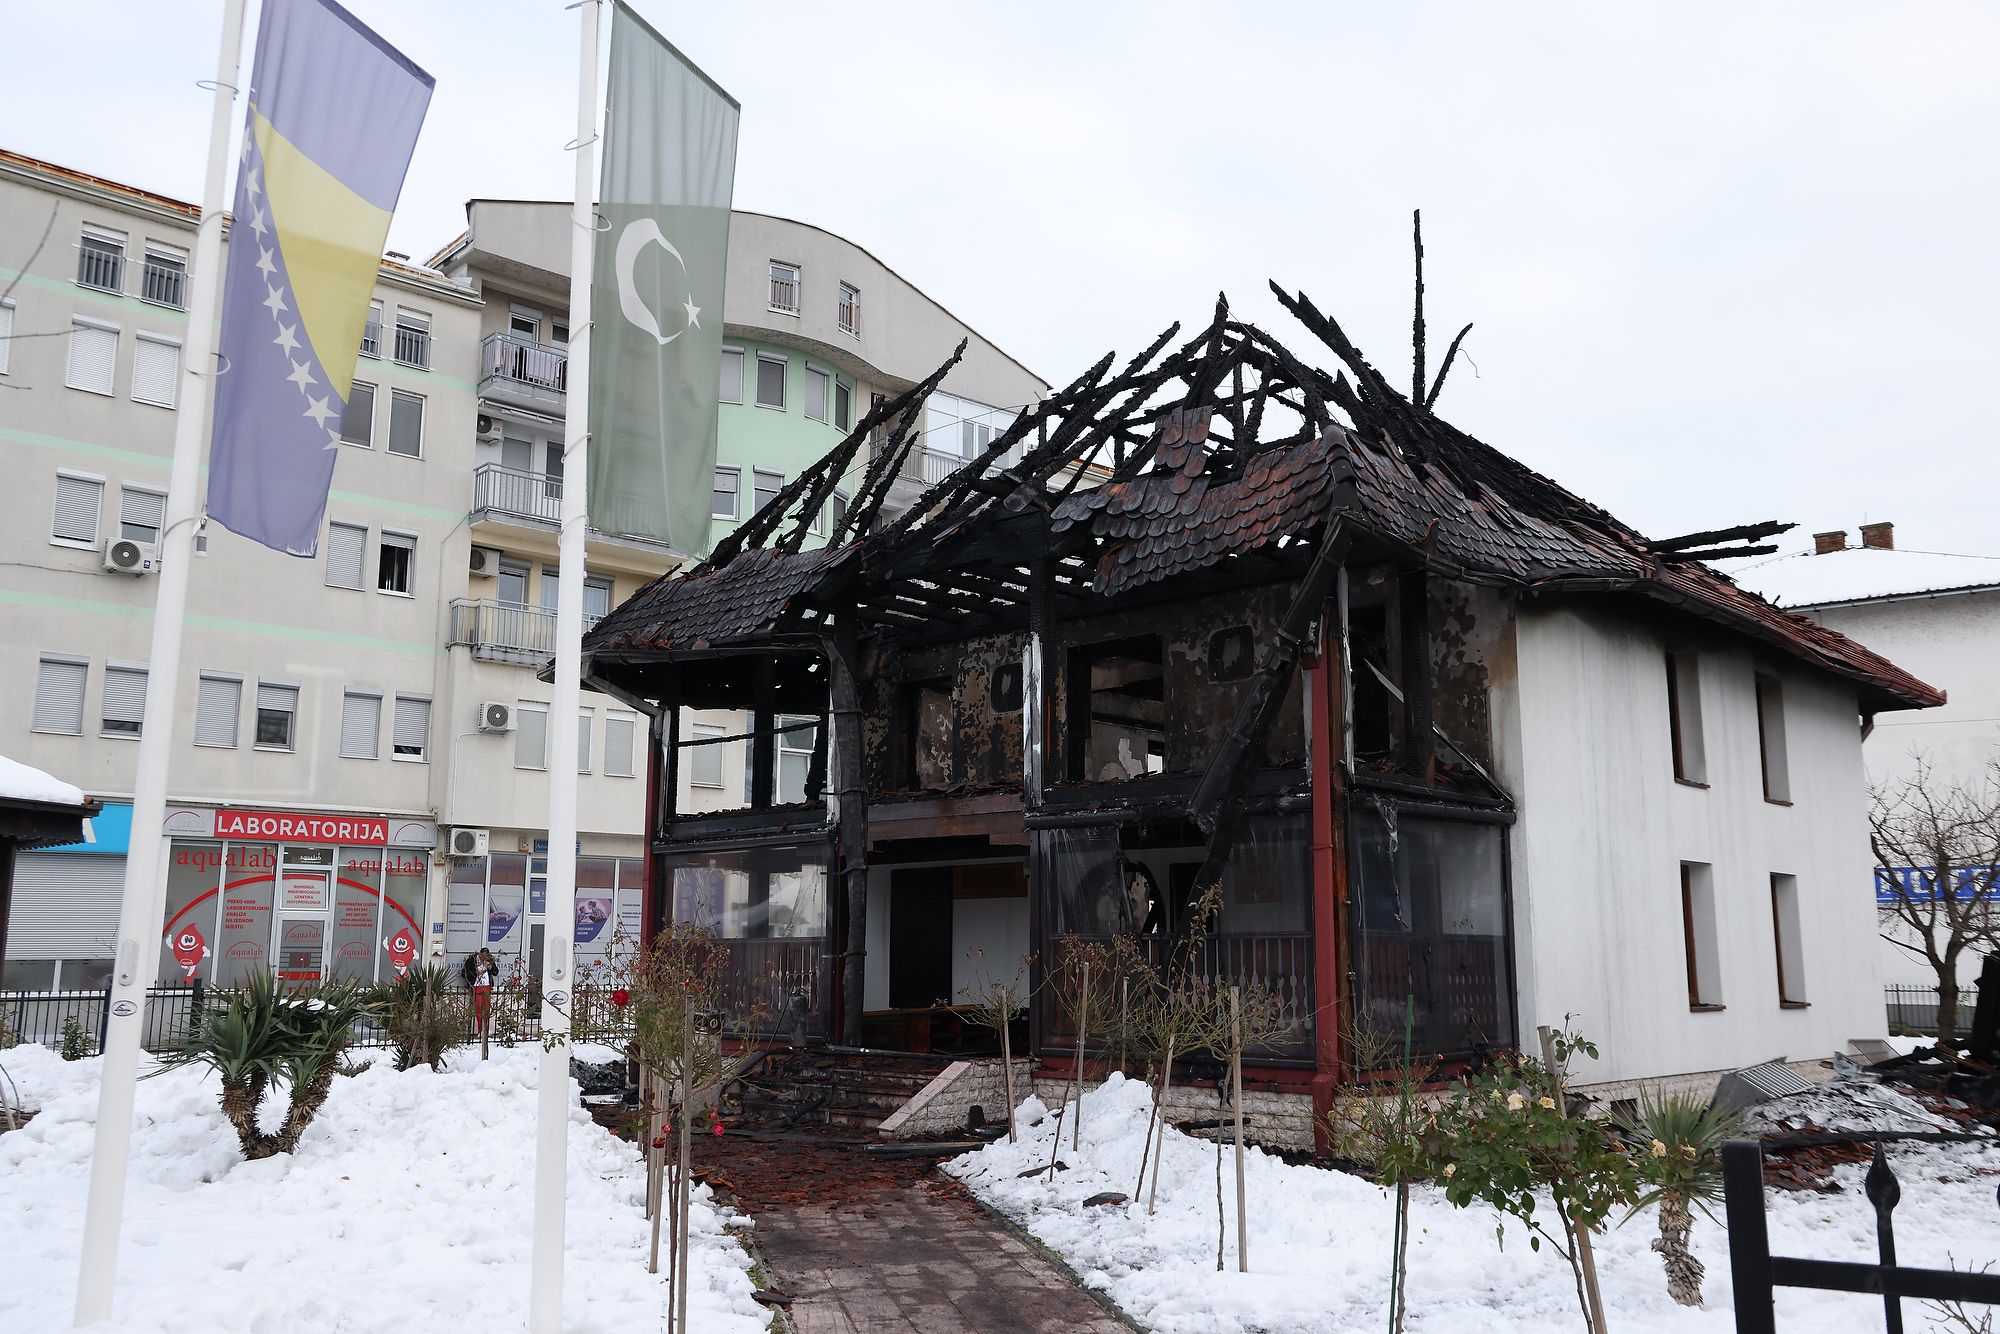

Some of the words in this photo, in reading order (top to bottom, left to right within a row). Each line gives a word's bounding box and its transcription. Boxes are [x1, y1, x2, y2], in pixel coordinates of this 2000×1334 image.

[217, 815, 385, 841] LABORATORIJA
[176, 846, 277, 873] aqualab
[347, 855, 425, 877] aqualab
[290, 930, 321, 939] aqualab
[231, 946, 263, 957] aqualab
